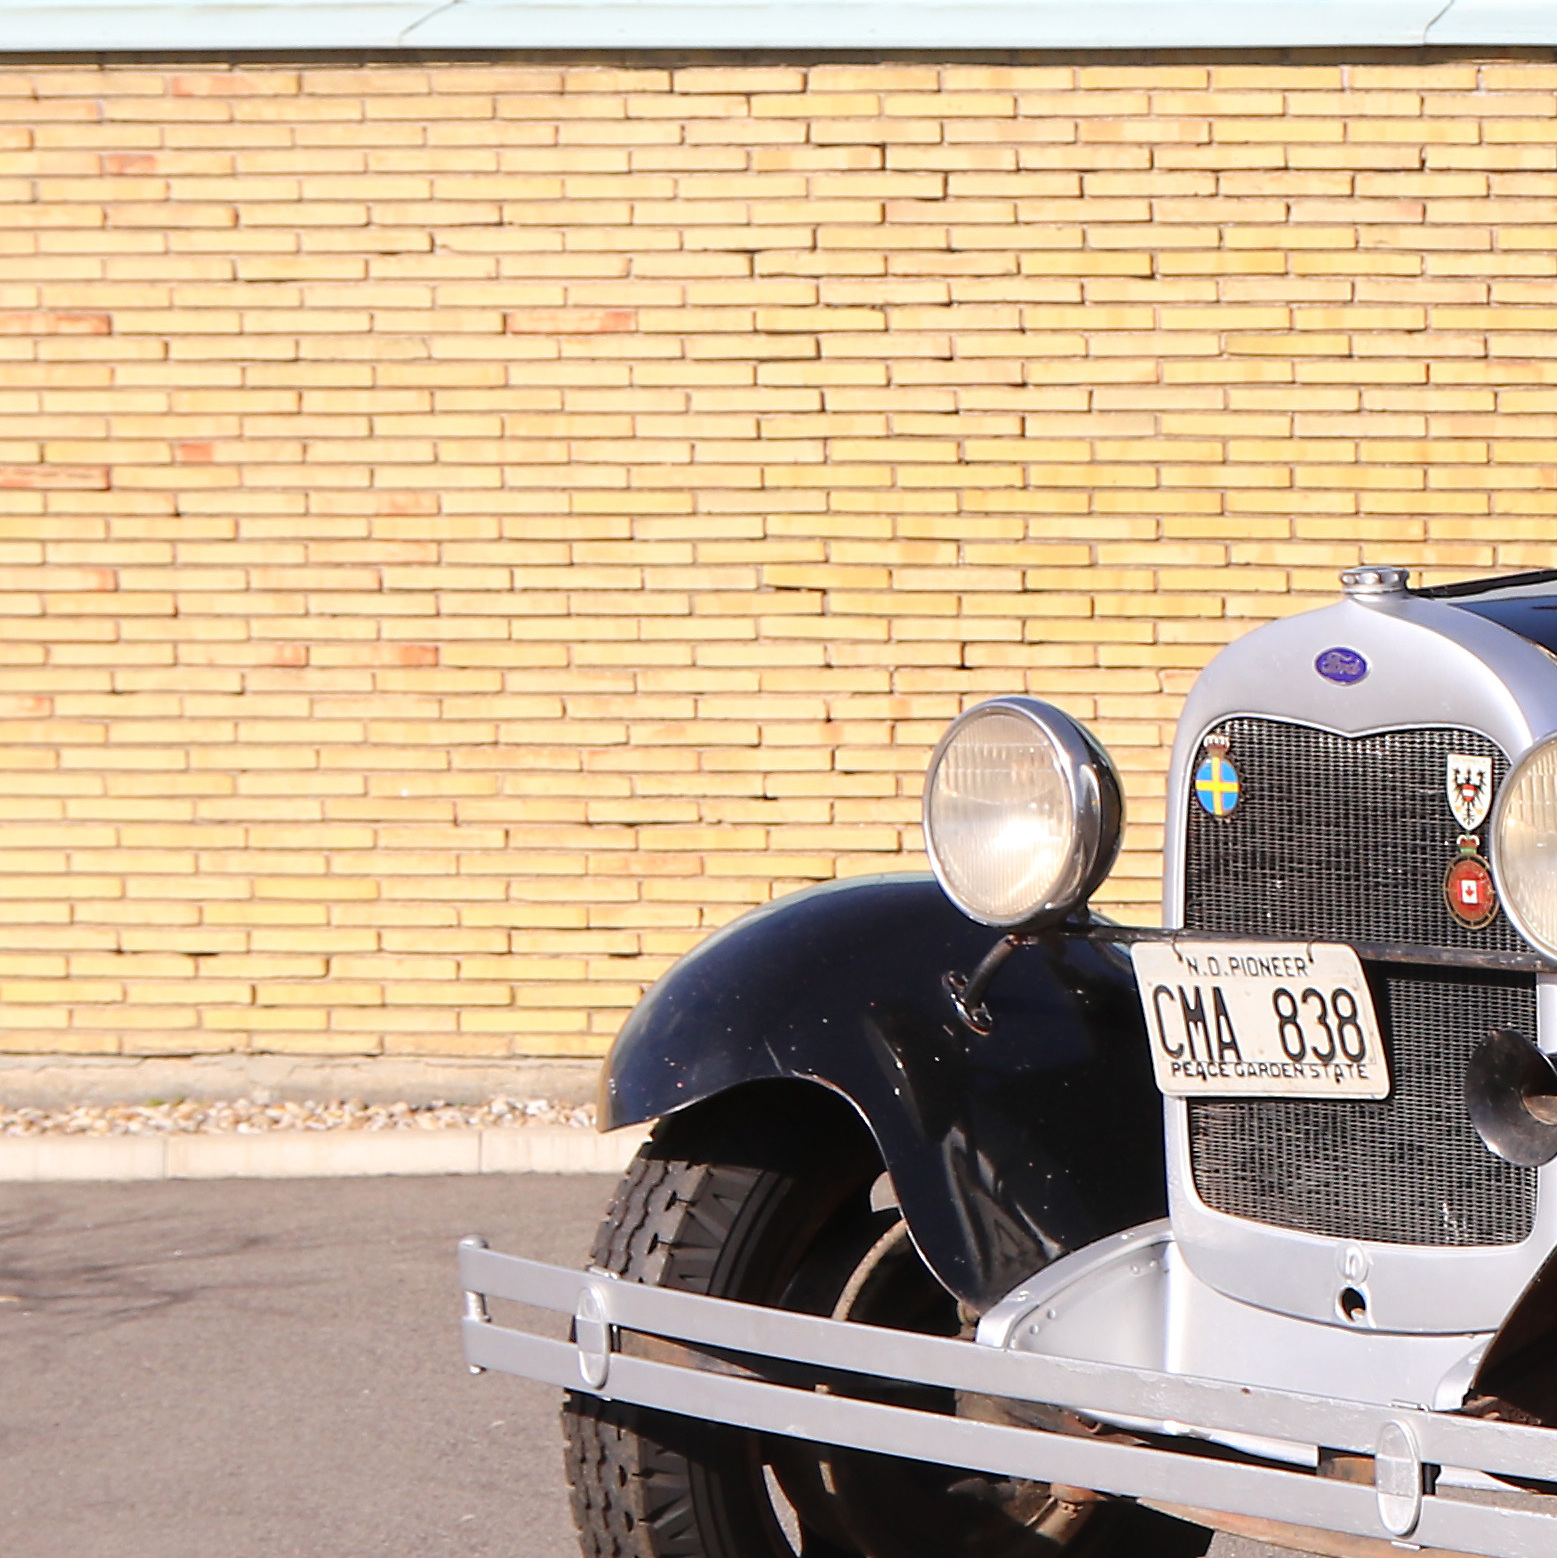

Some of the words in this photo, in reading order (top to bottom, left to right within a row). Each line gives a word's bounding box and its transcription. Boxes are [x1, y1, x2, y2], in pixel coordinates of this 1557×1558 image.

[1152, 984, 1243, 1063] CMA
[1271, 986, 1366, 1063] 838
[1171, 1061, 1228, 1078] PEACE
[1235, 1063, 1304, 1078] GARDEN
[1307, 1064, 1369, 1079] STATE
